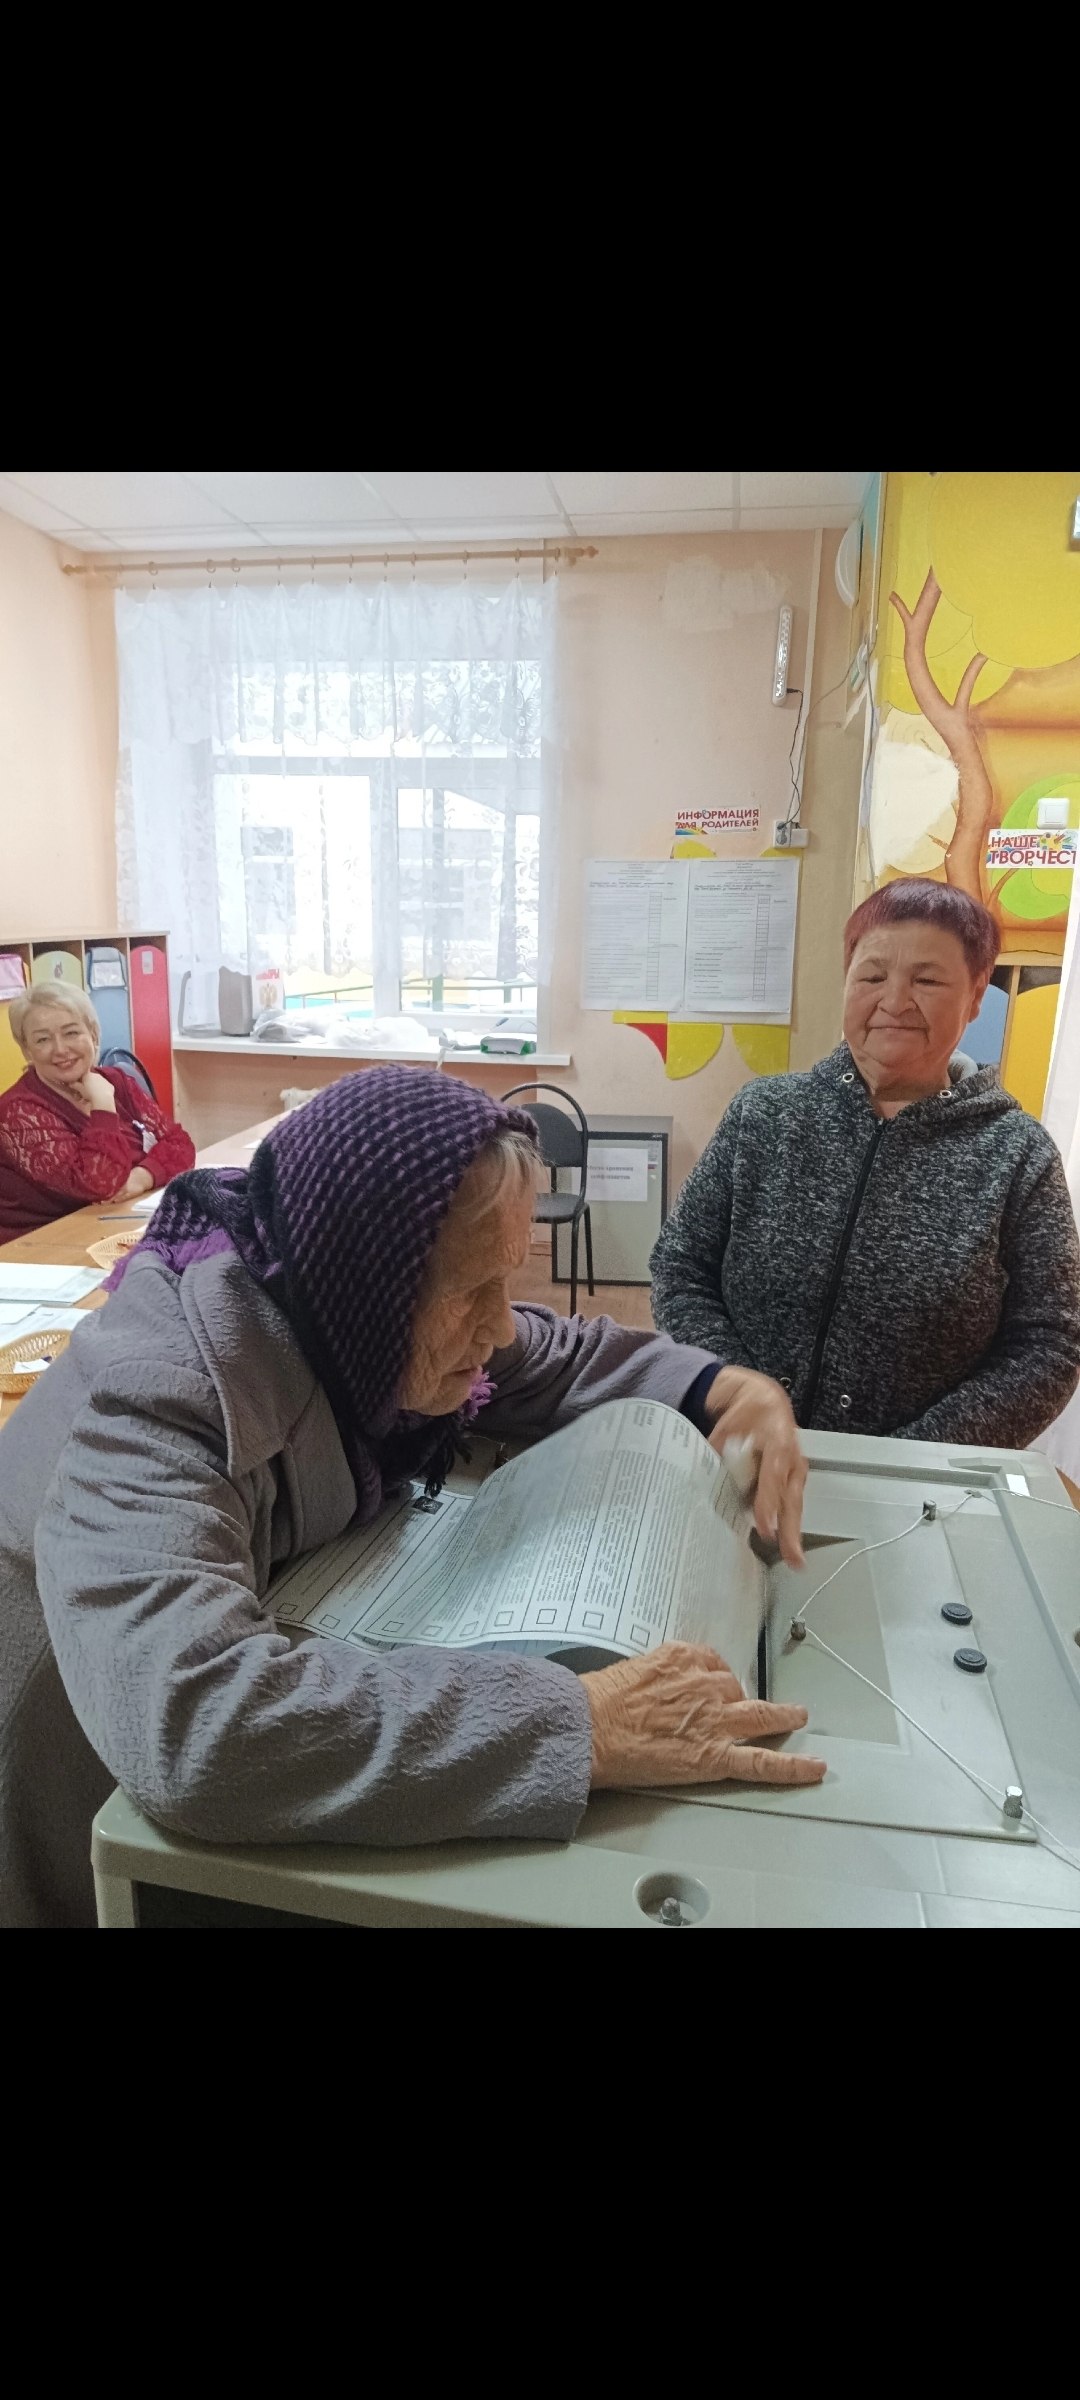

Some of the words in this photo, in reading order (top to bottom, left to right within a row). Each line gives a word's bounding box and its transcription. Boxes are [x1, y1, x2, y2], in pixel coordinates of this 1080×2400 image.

[678, 809, 759, 820] ИНФОРМАЦИЯ
[701, 818, 759, 829] РОДИТЕЛЕЙ
[991, 836, 1037, 848] НАШЕ
[990, 850, 1077, 865] ТВОРЧЕСТ
